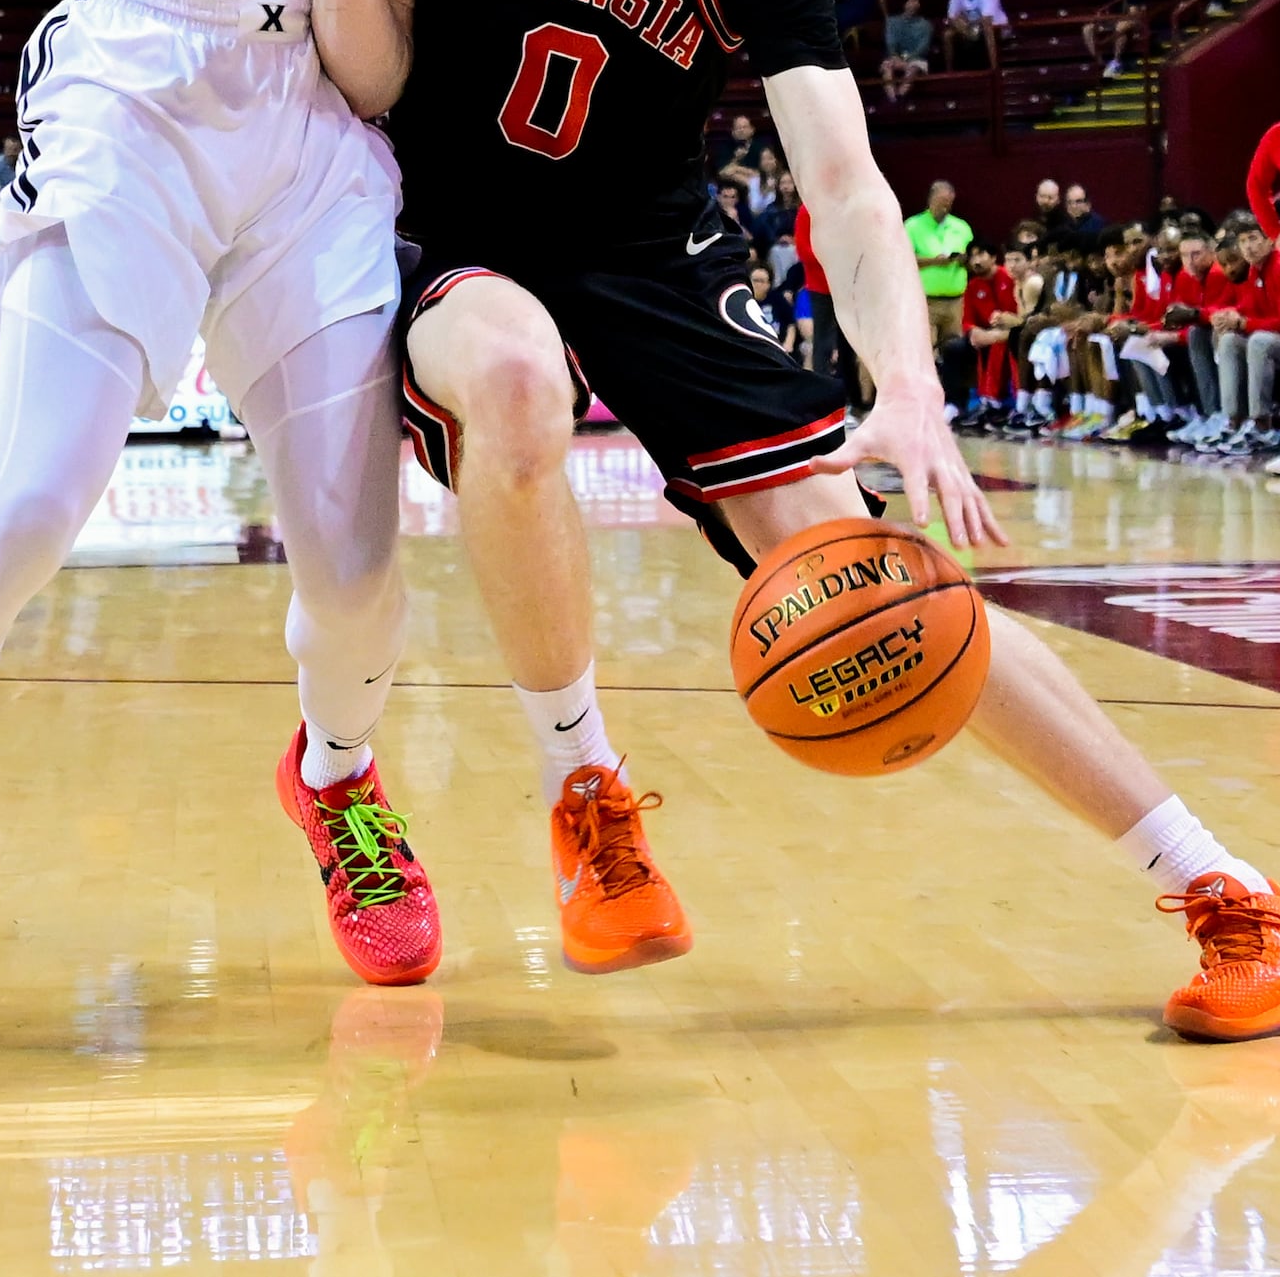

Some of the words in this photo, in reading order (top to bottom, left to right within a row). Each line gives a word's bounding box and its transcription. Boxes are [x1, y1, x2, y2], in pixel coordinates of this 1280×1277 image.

[259, 4, 285, 32] X
[497, 22, 610, 160] 0
[750, 552, 913, 658] SPALDING
[788, 615, 924, 707] LEGACY
[844, 651, 924, 704] 1000
